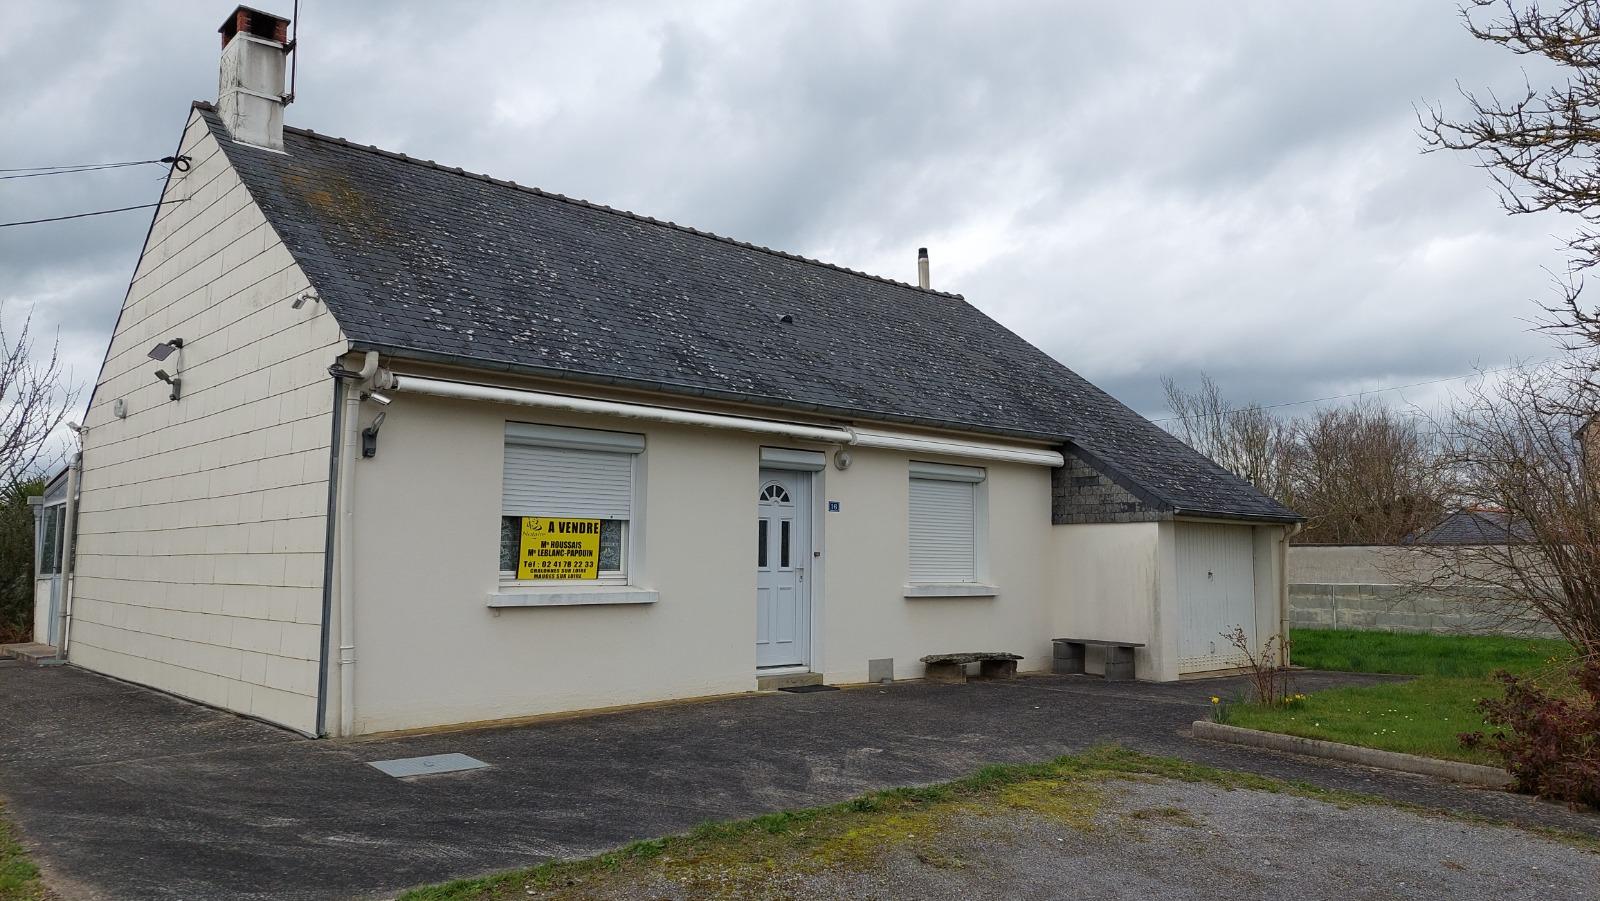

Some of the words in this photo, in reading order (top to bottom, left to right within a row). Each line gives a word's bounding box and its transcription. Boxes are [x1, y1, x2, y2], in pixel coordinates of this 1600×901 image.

[548, 521, 555, 533] A
[559, 522, 599, 534] VENDRE
[551, 541, 582, 549] HOUSSAIS
[538, 549, 593, 557] LEBLANC-PAPOUIN
